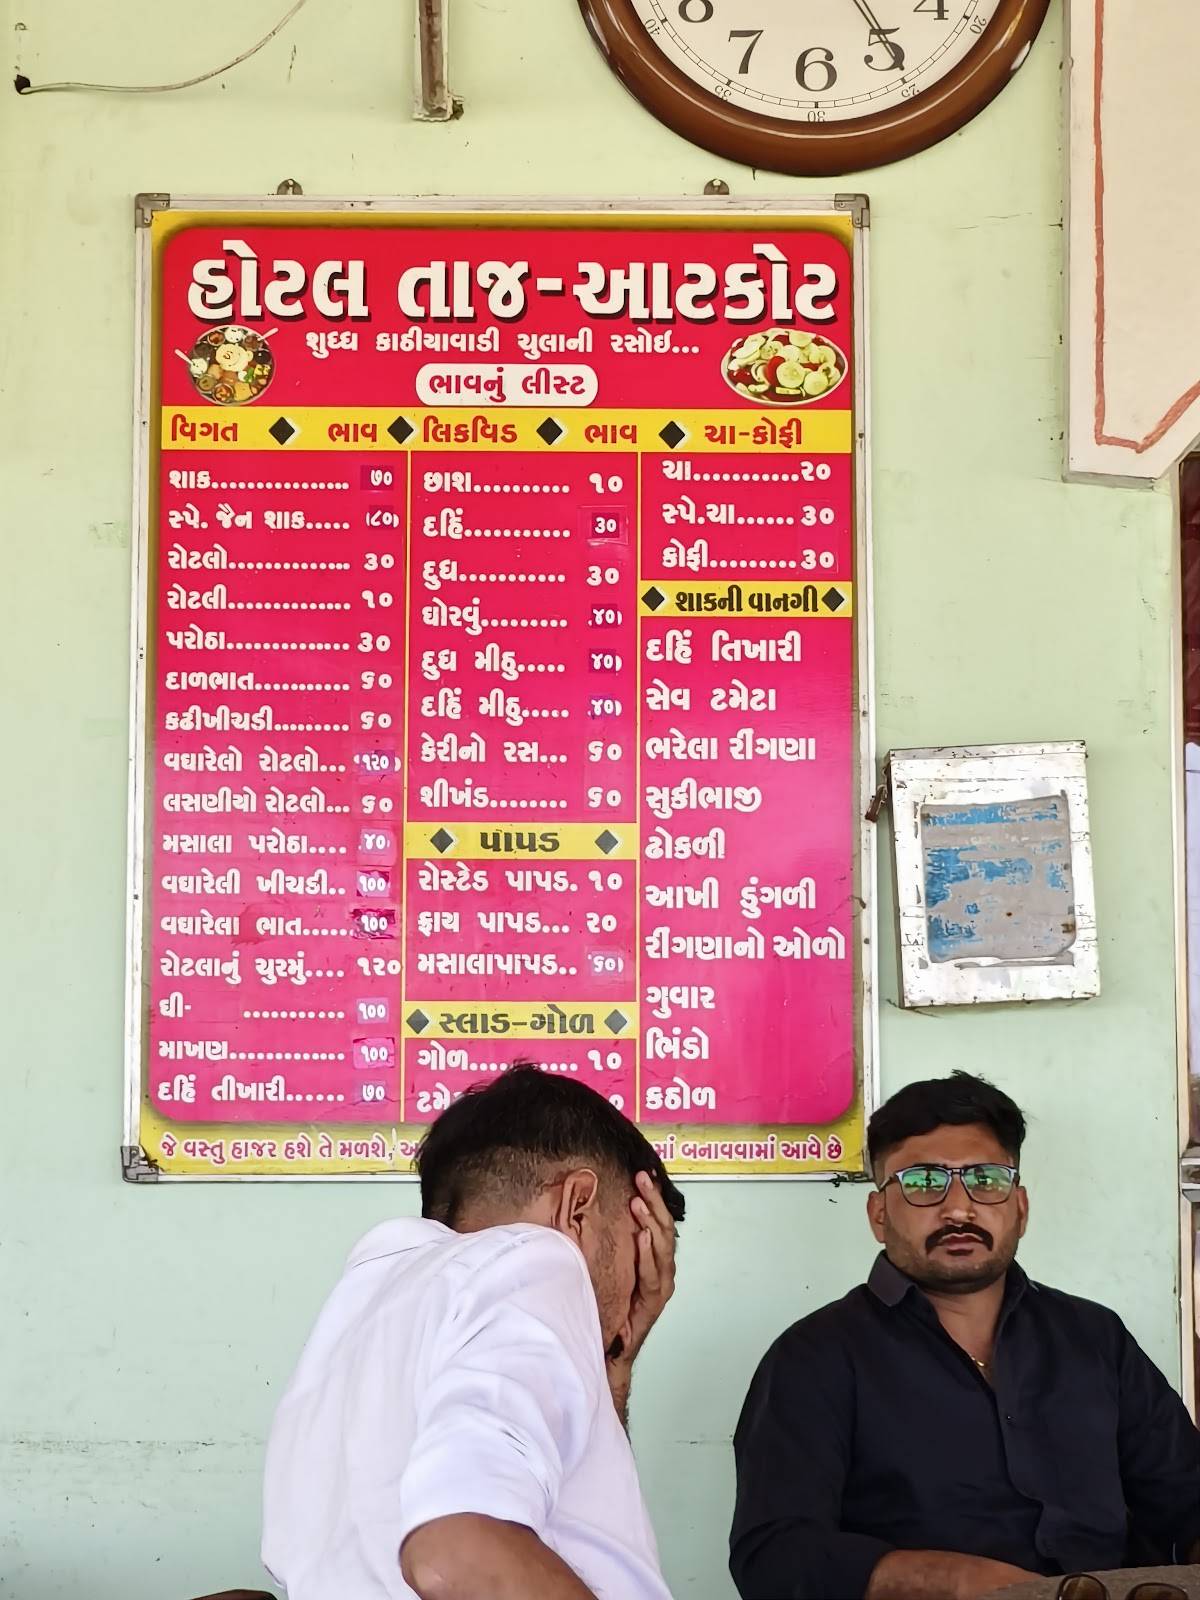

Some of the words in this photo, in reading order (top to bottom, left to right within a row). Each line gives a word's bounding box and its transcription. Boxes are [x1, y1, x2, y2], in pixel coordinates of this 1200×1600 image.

[728, 30, 764, 75] 7
[864, 28, 905, 71] 5
[795, 47, 837, 92] 6
[187, 240, 367, 322] હોટલ
[517, 327, 592, 360] ચુલાની
[429, 367, 506, 402] ભાવનું
[521, 368, 585, 395] લીસ્ટ
[171, 414, 238, 441] વિગત
[328, 423, 377, 442] ભાવ
[584, 423, 637, 445] ભાવ
[370, 470, 392, 486] ૭૦
[589, 473, 623, 493] ૧૦
[800, 461, 831, 481] ૨૦
[216, 503, 252, 529] જૈન
[595, 517, 617, 533] ૩૦
[801, 505, 834, 526] ૩૦
[364, 554, 394, 570] ૩૦
[801, 549, 834, 570] ૩૦
[587, 566, 619, 586] ૩૦
[362, 590, 393, 608] ૧૦
[675, 584, 743, 612] શાકની
[748, 584, 818, 612] વાનગી
[358, 632, 390, 652] ૩૦
[646, 629, 693, 664] દહિં
[711, 629, 802, 662] તિખારી
[421, 688, 462, 719] દહિં
[646, 678, 690, 711] સેવ
[710, 678, 776, 711] ટમેટા
[420, 732, 485, 762] કેરીનો
[646, 727, 718, 760] ભરેલા
[163, 745, 242, 772] વઘારેલો
[162, 786, 256, 812] લસણીયો
[646, 777, 762, 819] સુકીભાજી
[162, 835, 232, 853] મસાલા
[480, 829, 560, 852] પાપડ
[645, 826, 726, 859] ઢોકળી
[161, 868, 240, 894] વઘારેલી
[418, 861, 489, 891] રોસ્ટેડ
[588, 870, 622, 891] ૧૦
[645, 876, 719, 909] આખી
[740, 876, 816, 919] ડુંગળી
[160, 908, 239, 935] વઘારેલા
[586, 912, 617, 933] ૨૦
[773, 926, 846, 960] ઓળો
[160, 950, 242, 985] રોટલાનું
[356, 957, 401, 976] ૧૨૦
[359, 1002, 386, 1020] ૧૦૦
[646, 986, 715, 1019] ગુવાર
[361, 1045, 388, 1062] ૧૦૦
[646, 1026, 709, 1060] ભિંડો
[587, 1050, 622, 1070] ૧૦
[158, 1074, 197, 1103] દહિં
[363, 1084, 385, 1101] ૭૦
[645, 1077, 716, 1110] કઠોળ
[161, 1133, 177, 1158] જે
[184, 1141, 225, 1163] વસ્તુ
[232, 1141, 276, 1158] હાજર
[284, 1133, 311, 1158] હશે
[319, 1133, 332, 1158] તે
[682, 1136, 775, 1160] બનાવવામાં
[782, 1136, 821, 1159] આવે
[827, 1137, 842, 1159] છે
